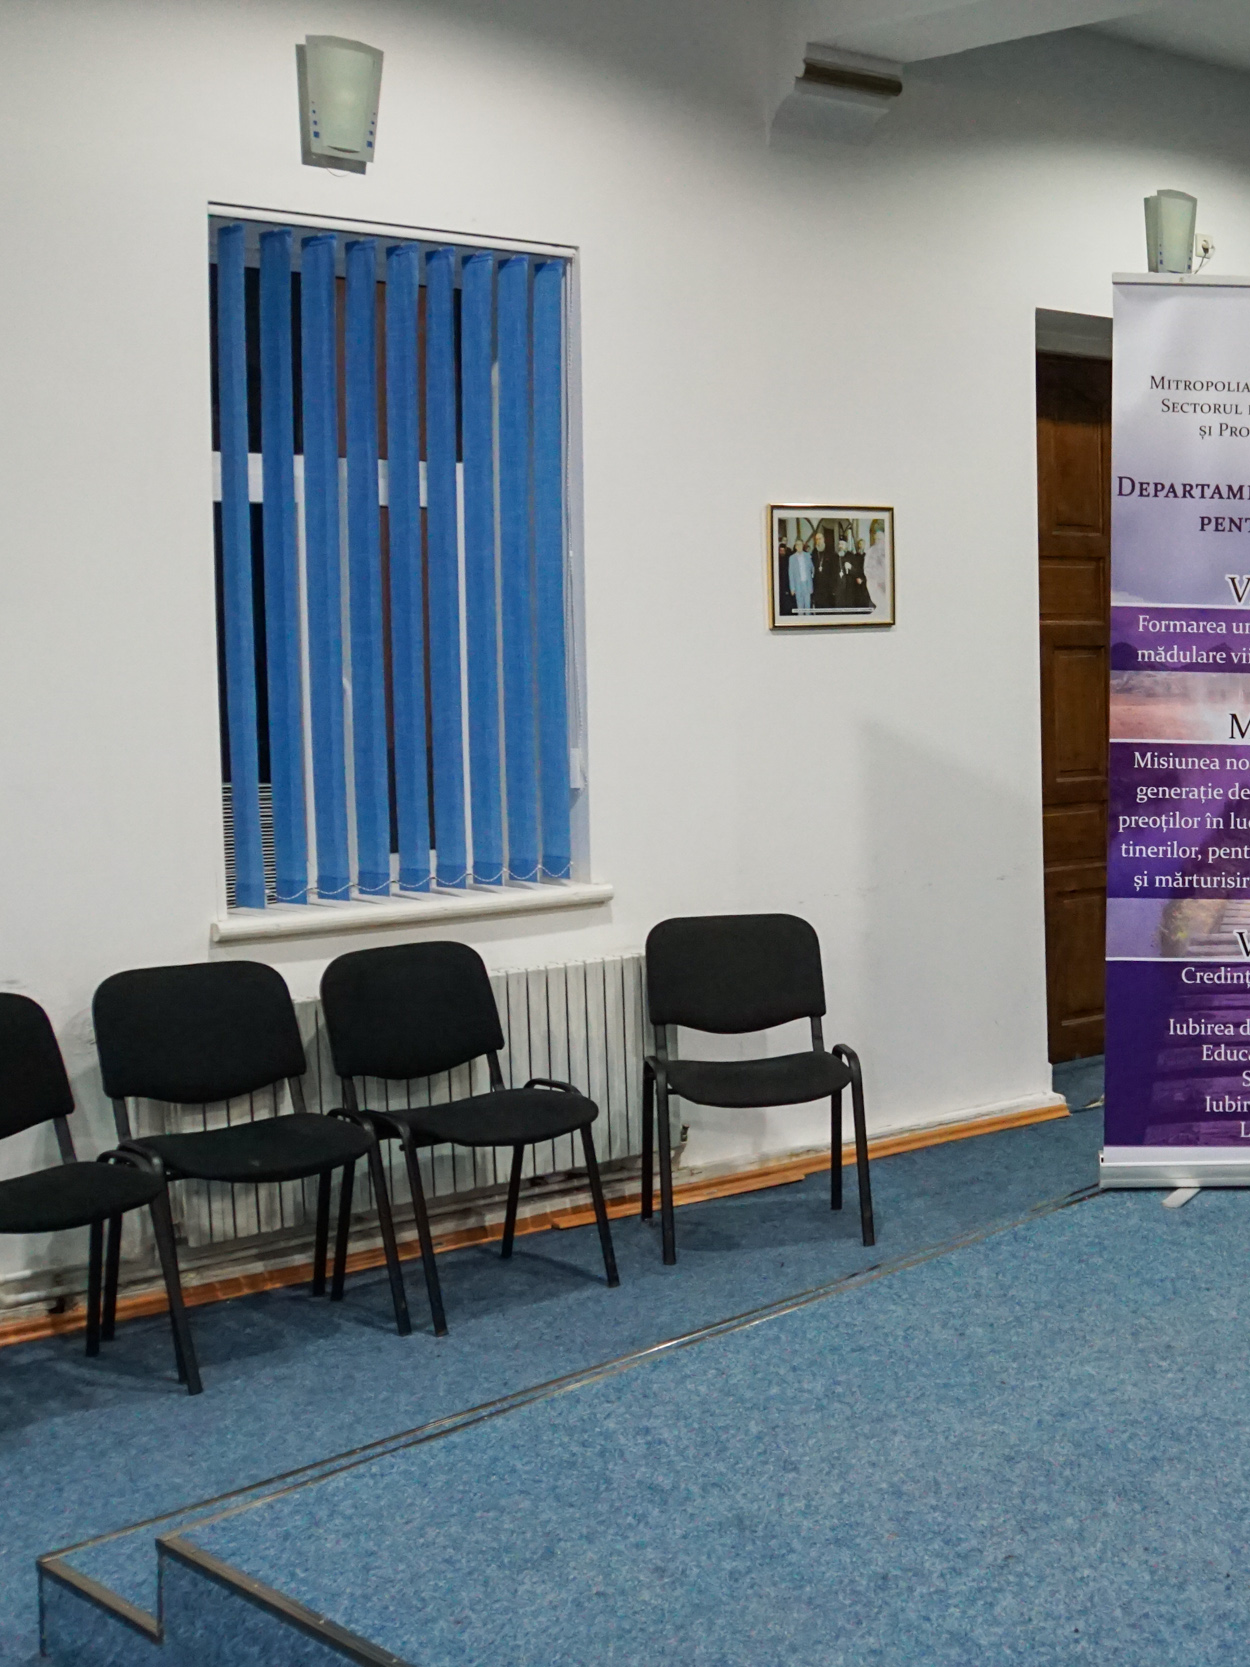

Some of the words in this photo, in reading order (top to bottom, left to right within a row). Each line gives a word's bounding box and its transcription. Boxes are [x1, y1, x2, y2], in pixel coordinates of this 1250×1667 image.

[1138, 615, 1226, 634] Formarea
[1137, 646, 1226, 663] mădulare
[1134, 752, 1219, 770] Misiunea
[1136, 785, 1223, 802] generație
[1228, 784, 1250, 800] de
[1119, 814, 1200, 833] preoților
[1205, 815, 1223, 830] în
[1121, 841, 1201, 861] tinerilor,
[1134, 872, 1148, 891] și
[1169, 1019, 1234, 1036] Iubirea
